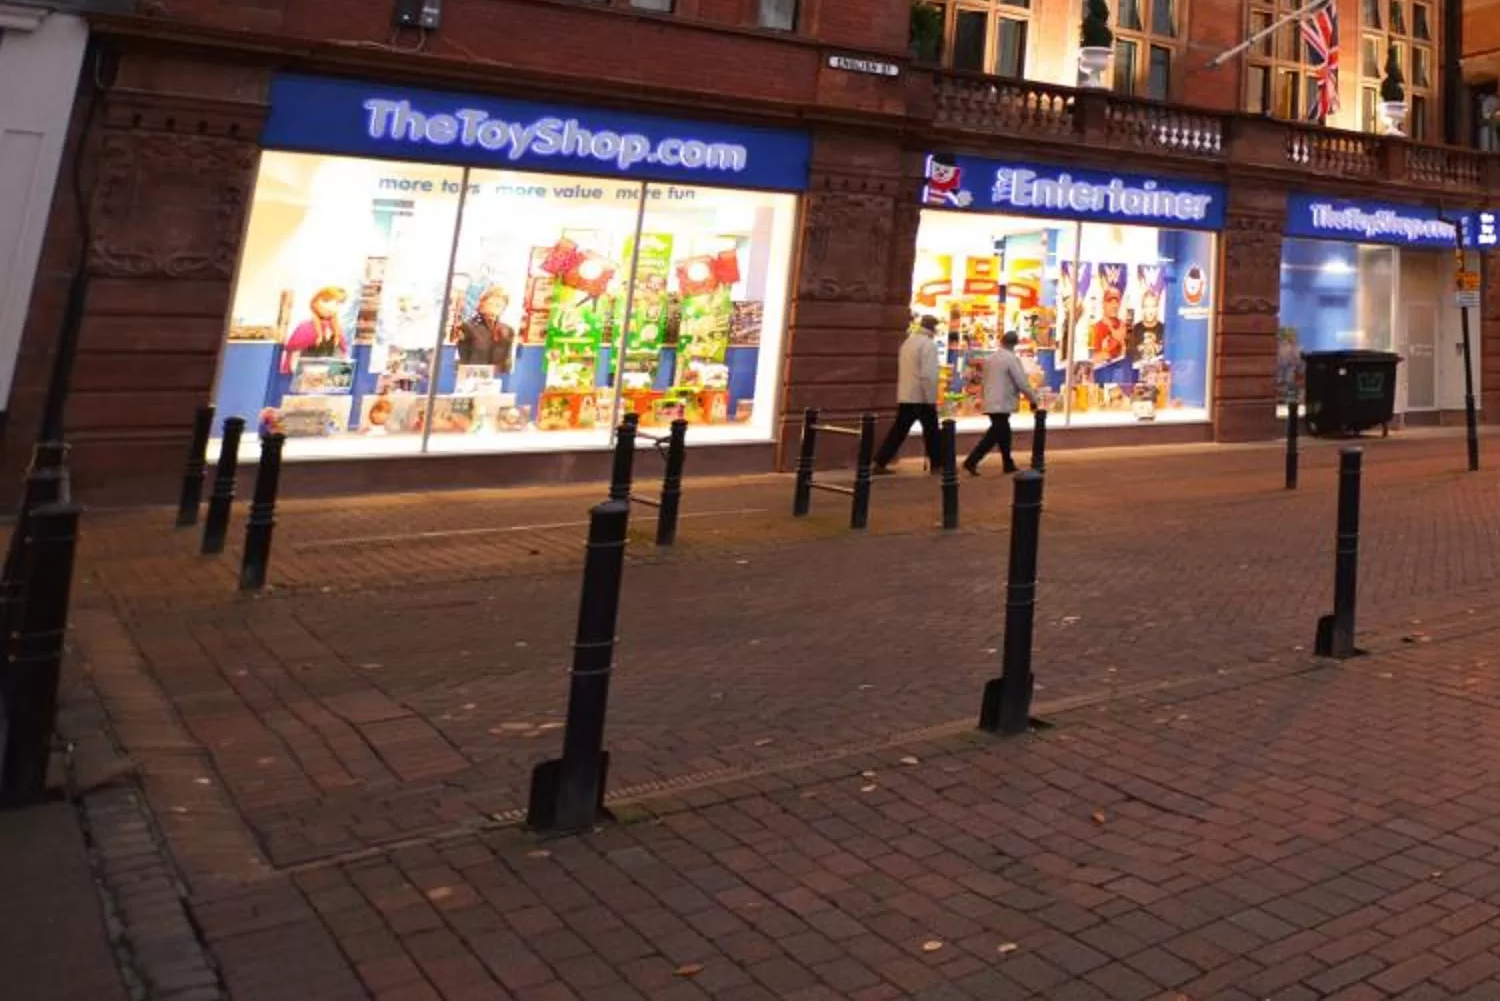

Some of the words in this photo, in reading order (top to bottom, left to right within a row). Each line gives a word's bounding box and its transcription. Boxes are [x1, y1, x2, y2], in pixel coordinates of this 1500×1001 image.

[364, 99, 747, 170] TheToyShop.com
[378, 175, 433, 193] more
[552, 183, 604, 199] value
[667, 185, 696, 200] fun
[1011, 169, 1212, 220] Entertainer
